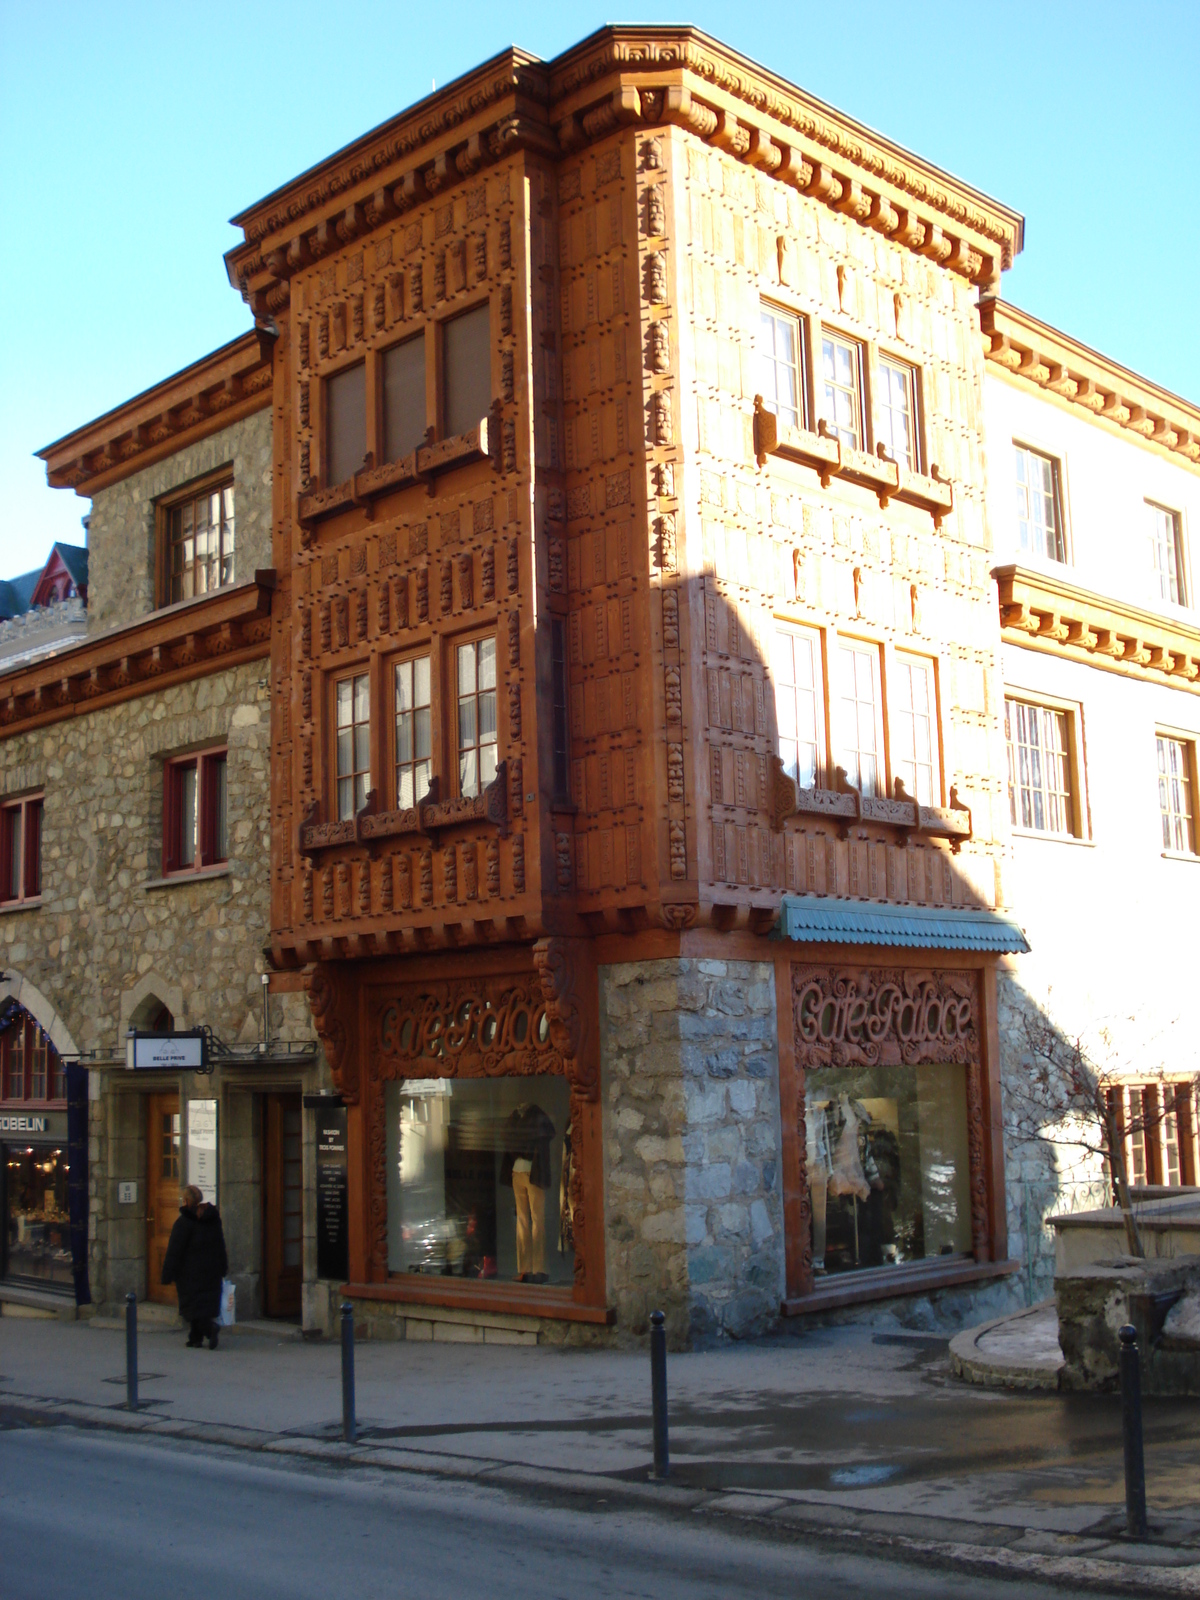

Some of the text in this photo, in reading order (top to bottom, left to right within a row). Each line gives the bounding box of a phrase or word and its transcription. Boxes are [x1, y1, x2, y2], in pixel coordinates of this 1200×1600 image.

[445, 988, 552, 1054] Palac
[867, 980, 971, 1042] Palace
[0, 1117, 45, 1131] OBELIN
